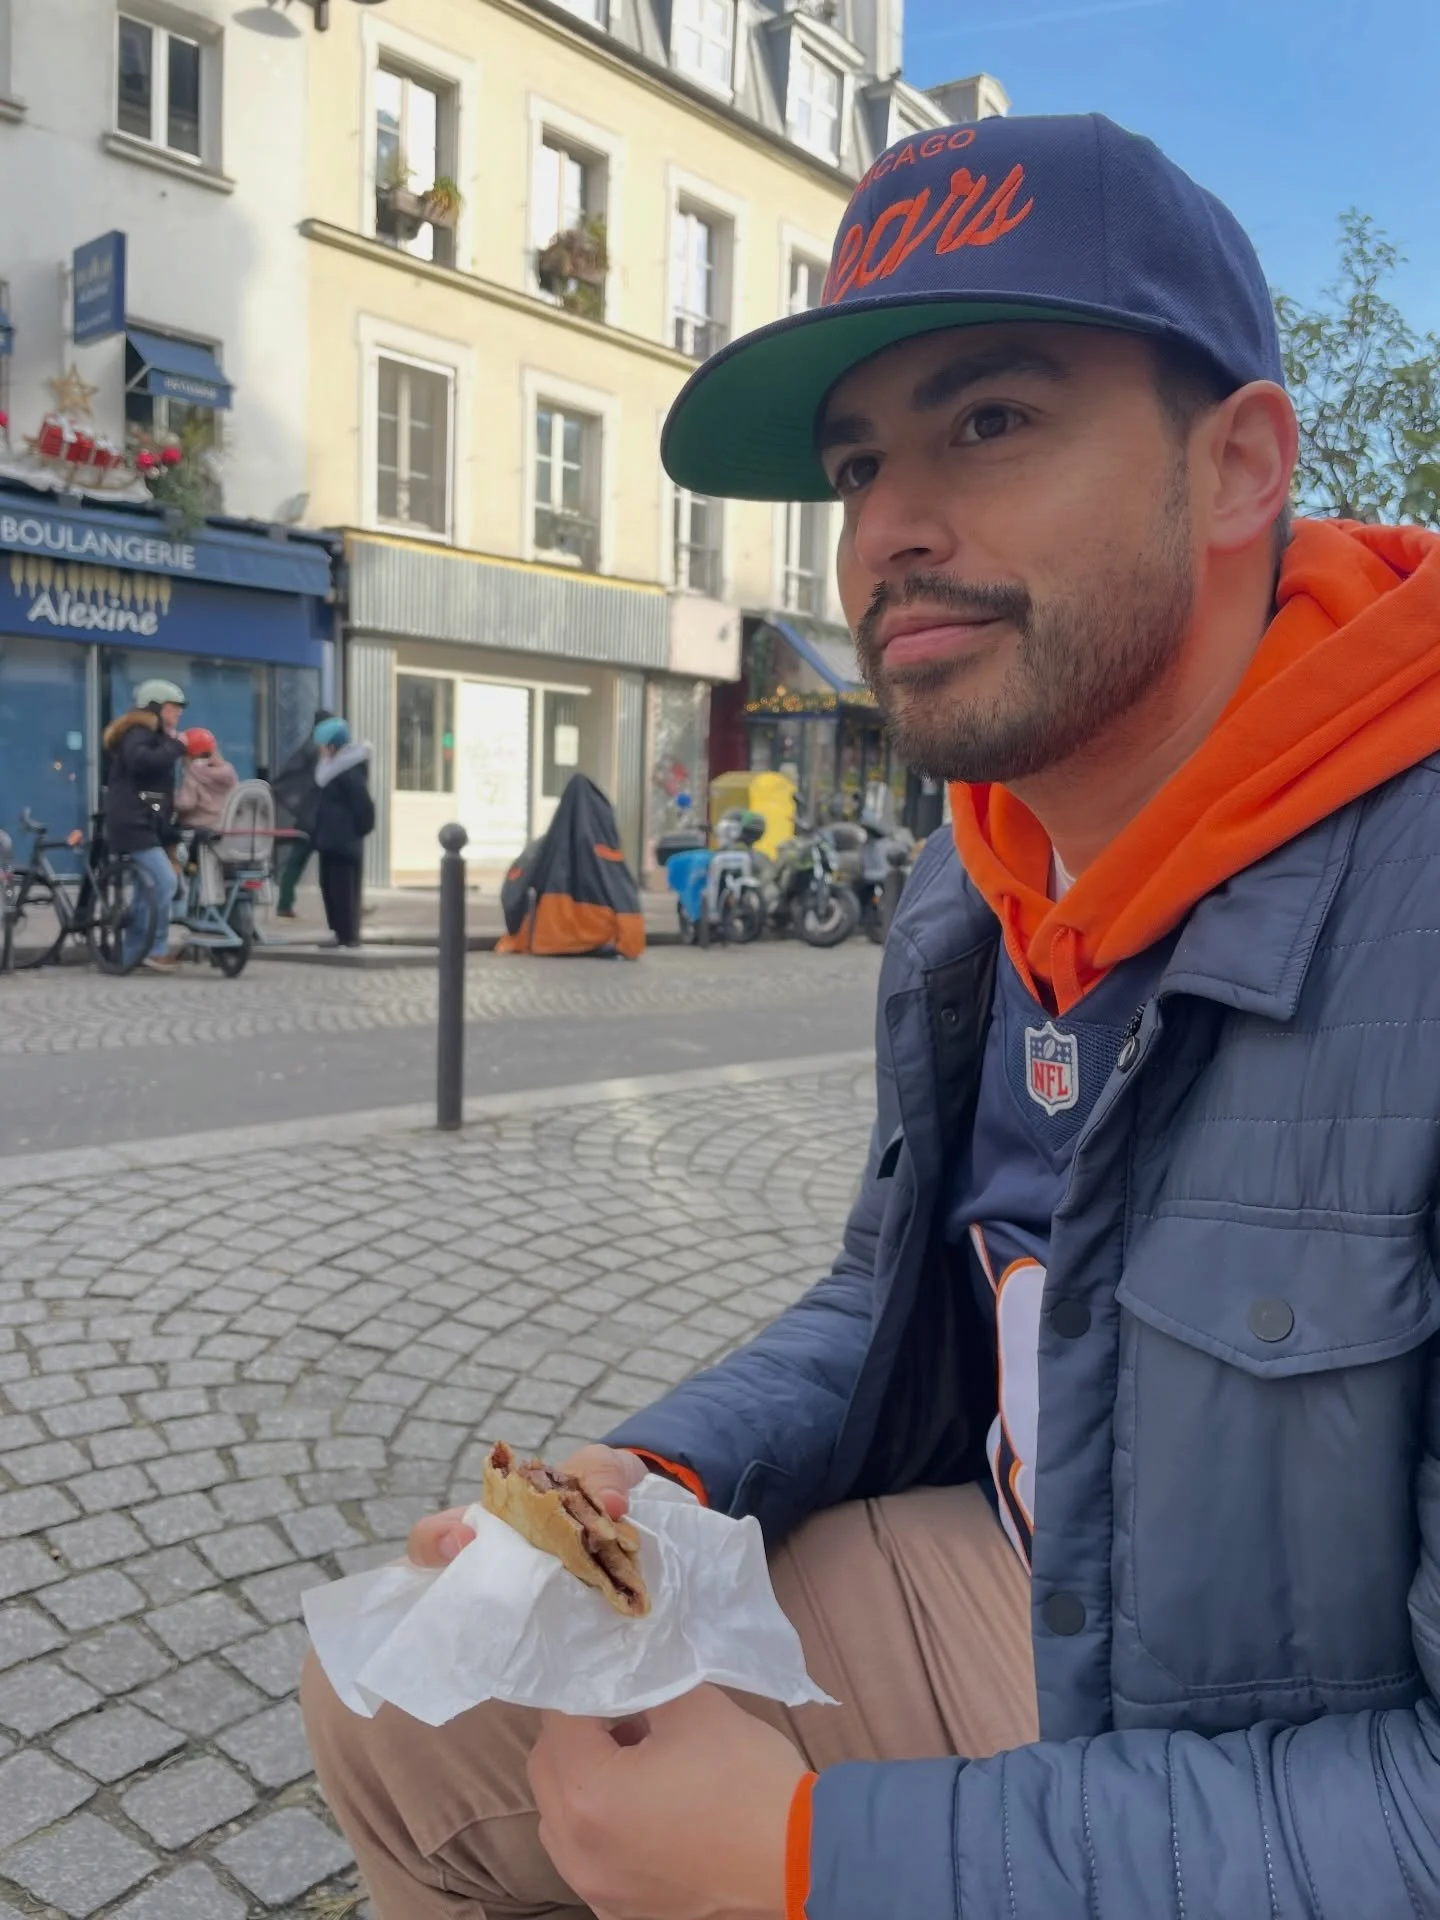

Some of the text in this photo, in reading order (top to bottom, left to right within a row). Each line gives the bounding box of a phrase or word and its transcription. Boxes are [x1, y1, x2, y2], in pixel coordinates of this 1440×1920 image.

[855, 129, 976, 194] ICAGO
[821, 163, 1035, 305] ears
[1, 514, 196, 570] BOULANGERIE
[27, 590, 158, 636] Alexine
[1033, 1061, 1069, 1099] NFL
